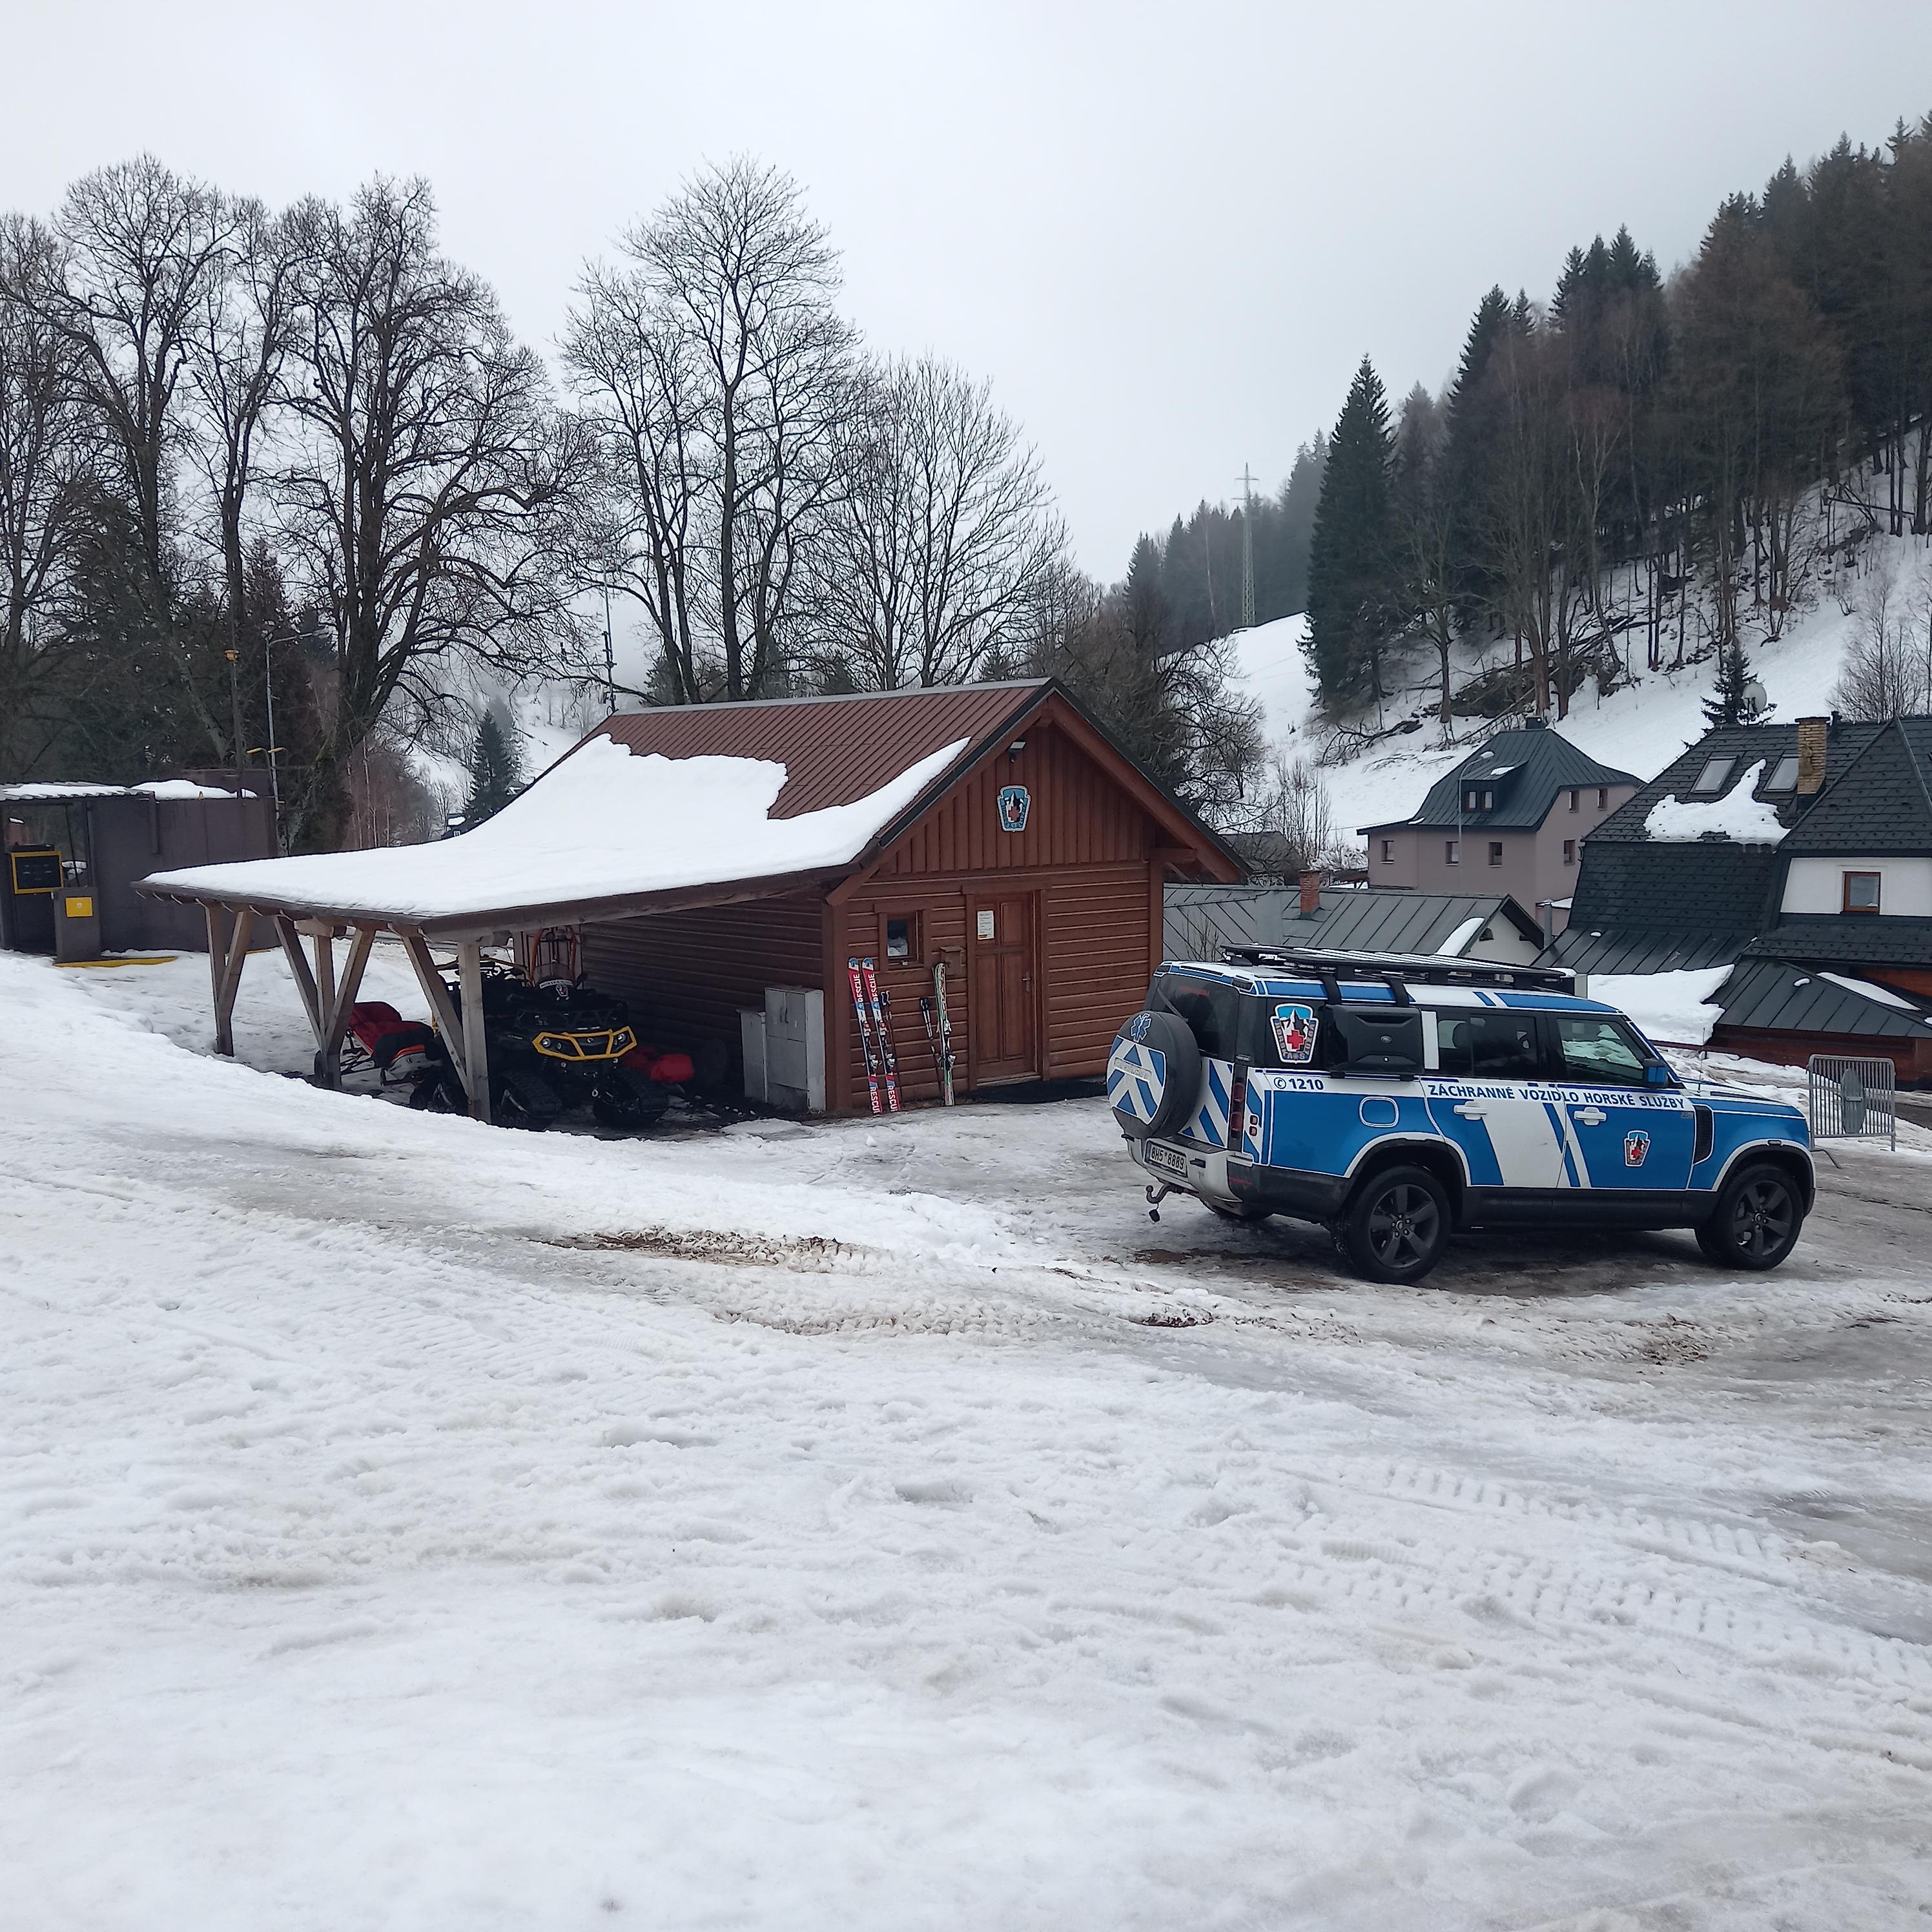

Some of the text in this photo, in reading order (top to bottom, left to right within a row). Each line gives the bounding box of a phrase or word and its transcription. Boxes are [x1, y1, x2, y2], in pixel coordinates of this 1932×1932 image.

[1428, 1084, 1683, 1109] ZÁCHRANNÉ VOZIDLO HORSKÉ SLUŽBY
[1151, 1147, 1184, 1169] 8H5 8889
